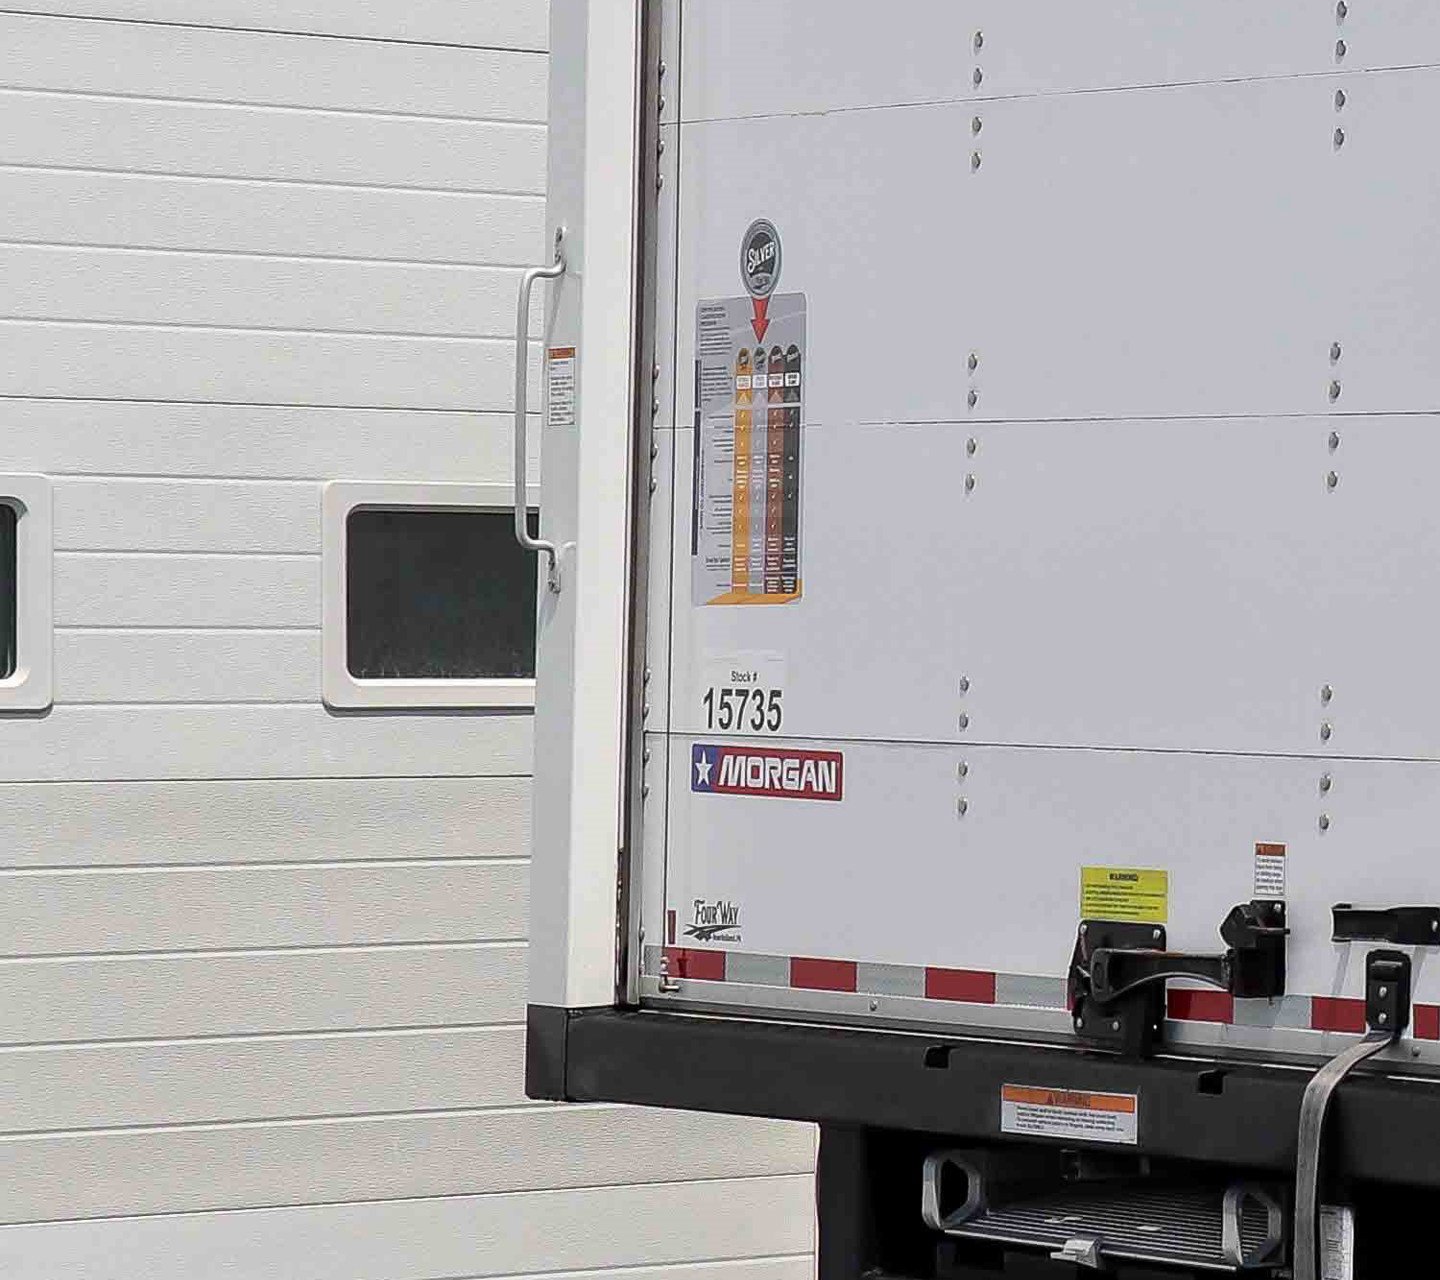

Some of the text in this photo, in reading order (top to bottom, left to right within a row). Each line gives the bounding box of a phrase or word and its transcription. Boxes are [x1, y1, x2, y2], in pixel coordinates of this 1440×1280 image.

[748, 241, 775, 274] SILVER
[731, 671, 750, 682] Stock
[703, 687, 782, 732] 15735
[718, 754, 836, 793] MORGAN
